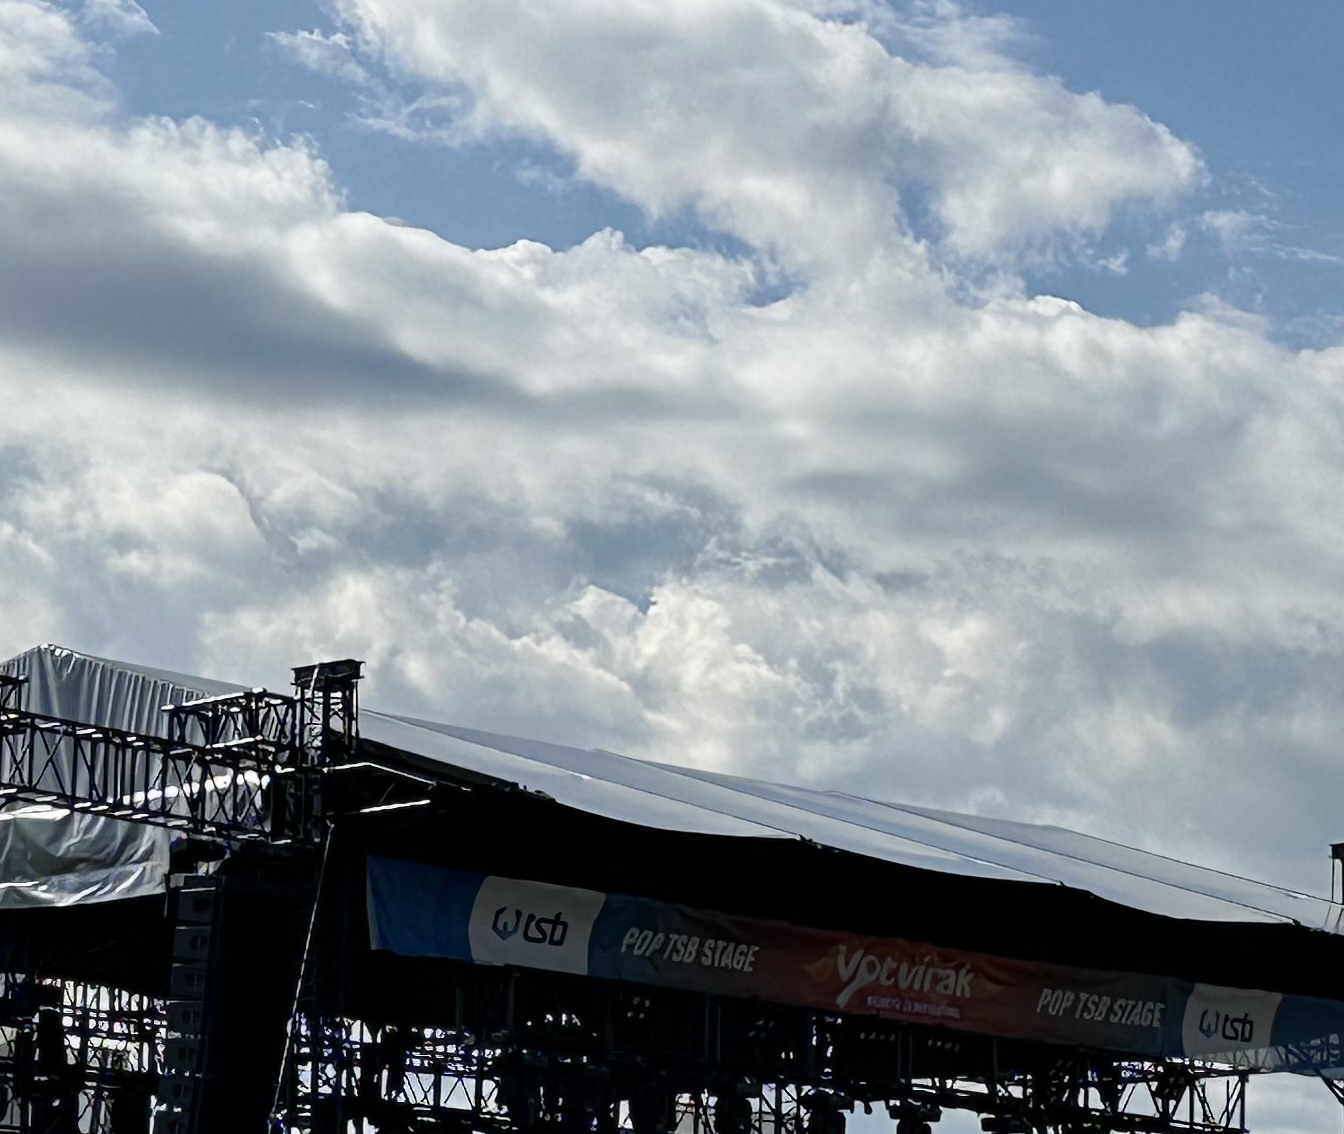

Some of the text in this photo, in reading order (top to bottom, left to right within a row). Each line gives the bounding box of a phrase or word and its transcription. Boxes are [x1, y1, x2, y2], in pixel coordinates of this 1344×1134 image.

[620, 926, 761, 973] POP TSB STAGE
[1036, 987, 1166, 1028] POP TSB STAGE
